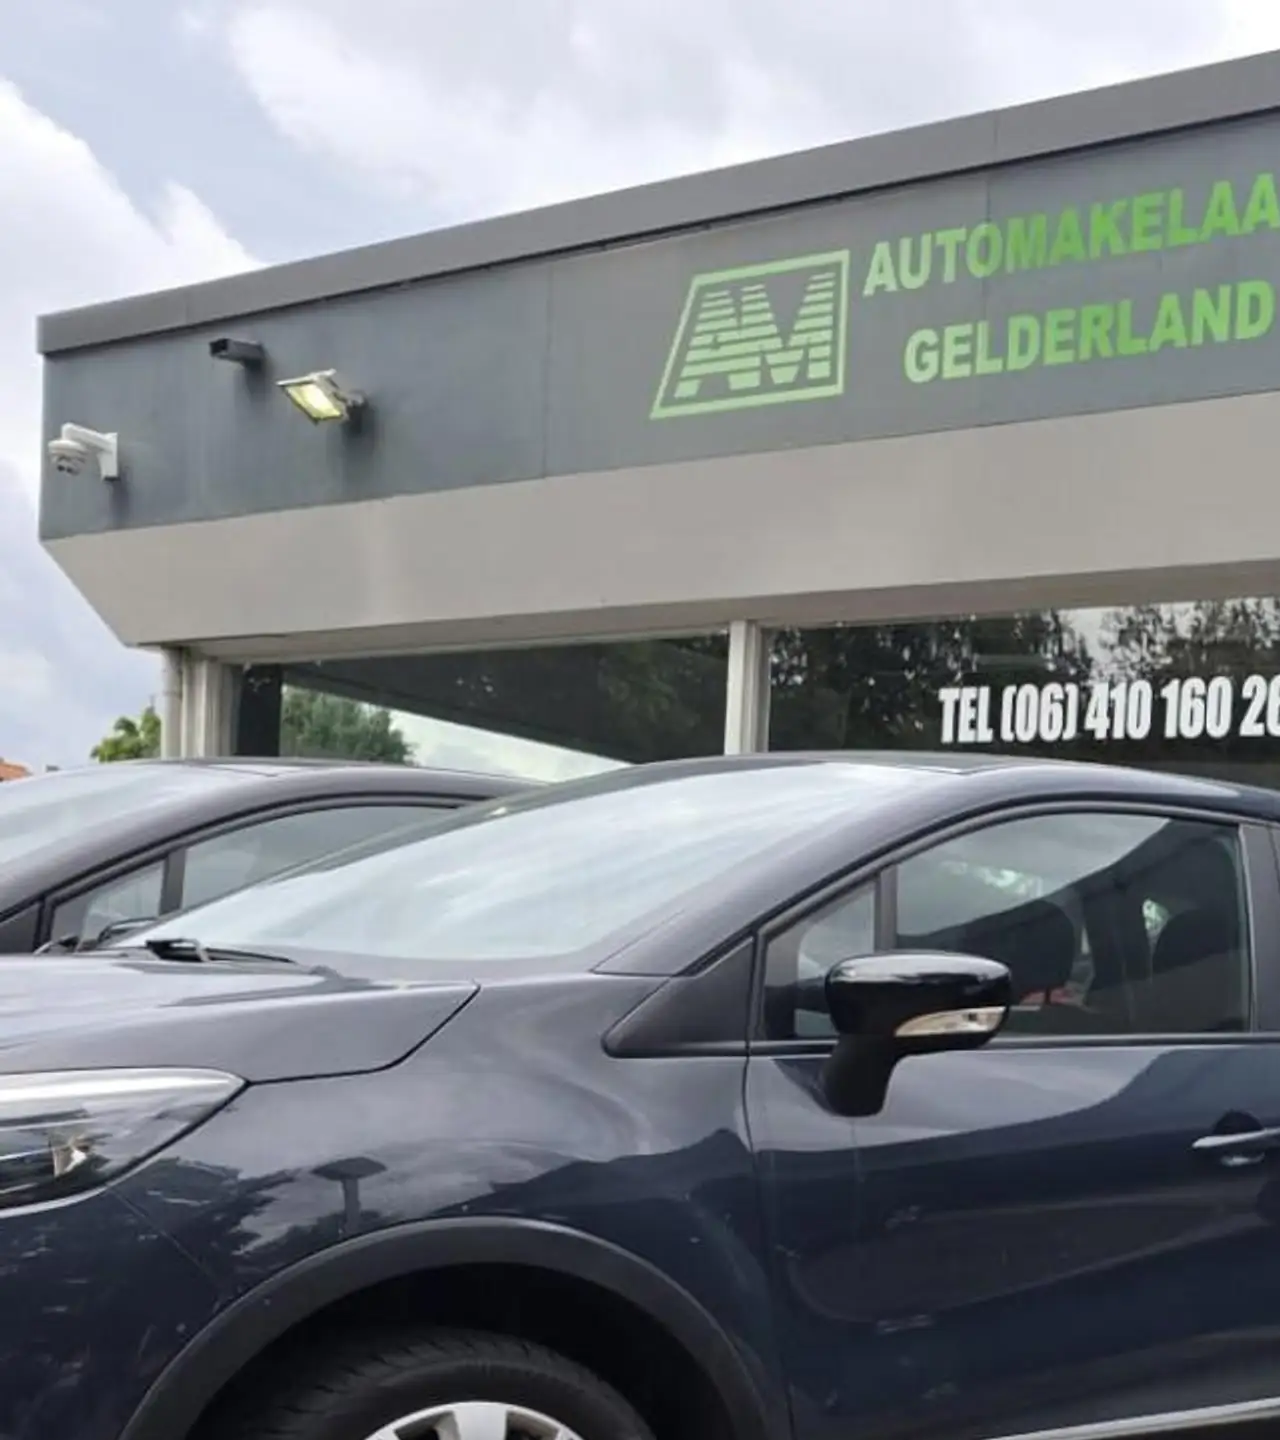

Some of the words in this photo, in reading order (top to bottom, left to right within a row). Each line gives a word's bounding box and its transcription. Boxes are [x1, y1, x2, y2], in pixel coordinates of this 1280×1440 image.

[672, 270, 836, 398] AM
[903, 279, 1276, 384] GELDERLAND
[938, 686, 993, 744] TEL
[1000, 683, 1079, 743] (06)
[1084, 679, 1153, 740] 410
[1160, 676, 1234, 740] 160
